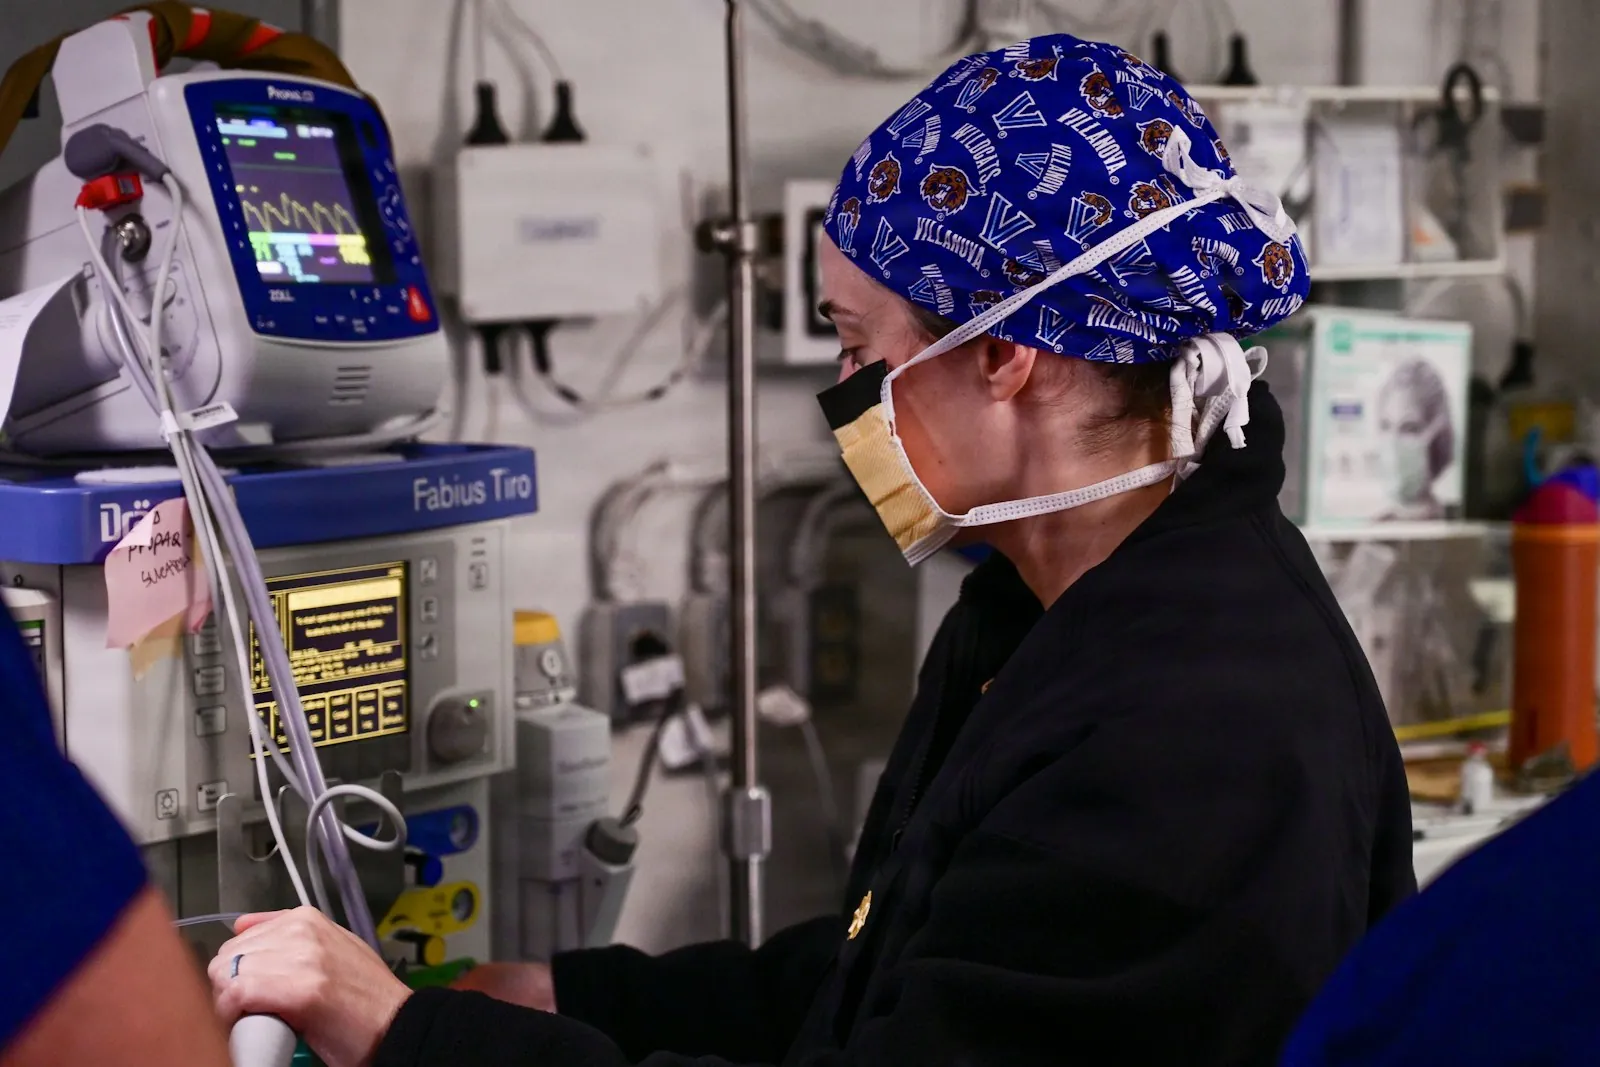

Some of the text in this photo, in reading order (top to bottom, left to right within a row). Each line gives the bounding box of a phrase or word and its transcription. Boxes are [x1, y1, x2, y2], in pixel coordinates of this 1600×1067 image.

[918, 114, 941, 156] VILLANOVA
[950, 122, 1001, 184] WILDCATS
[1056, 107, 1128, 176] VILLANOVA
[1033, 142, 1072, 195] VILLANOVA
[913, 217, 985, 271] VILLANOVA
[413, 467, 532, 512] Fabius Tiro
